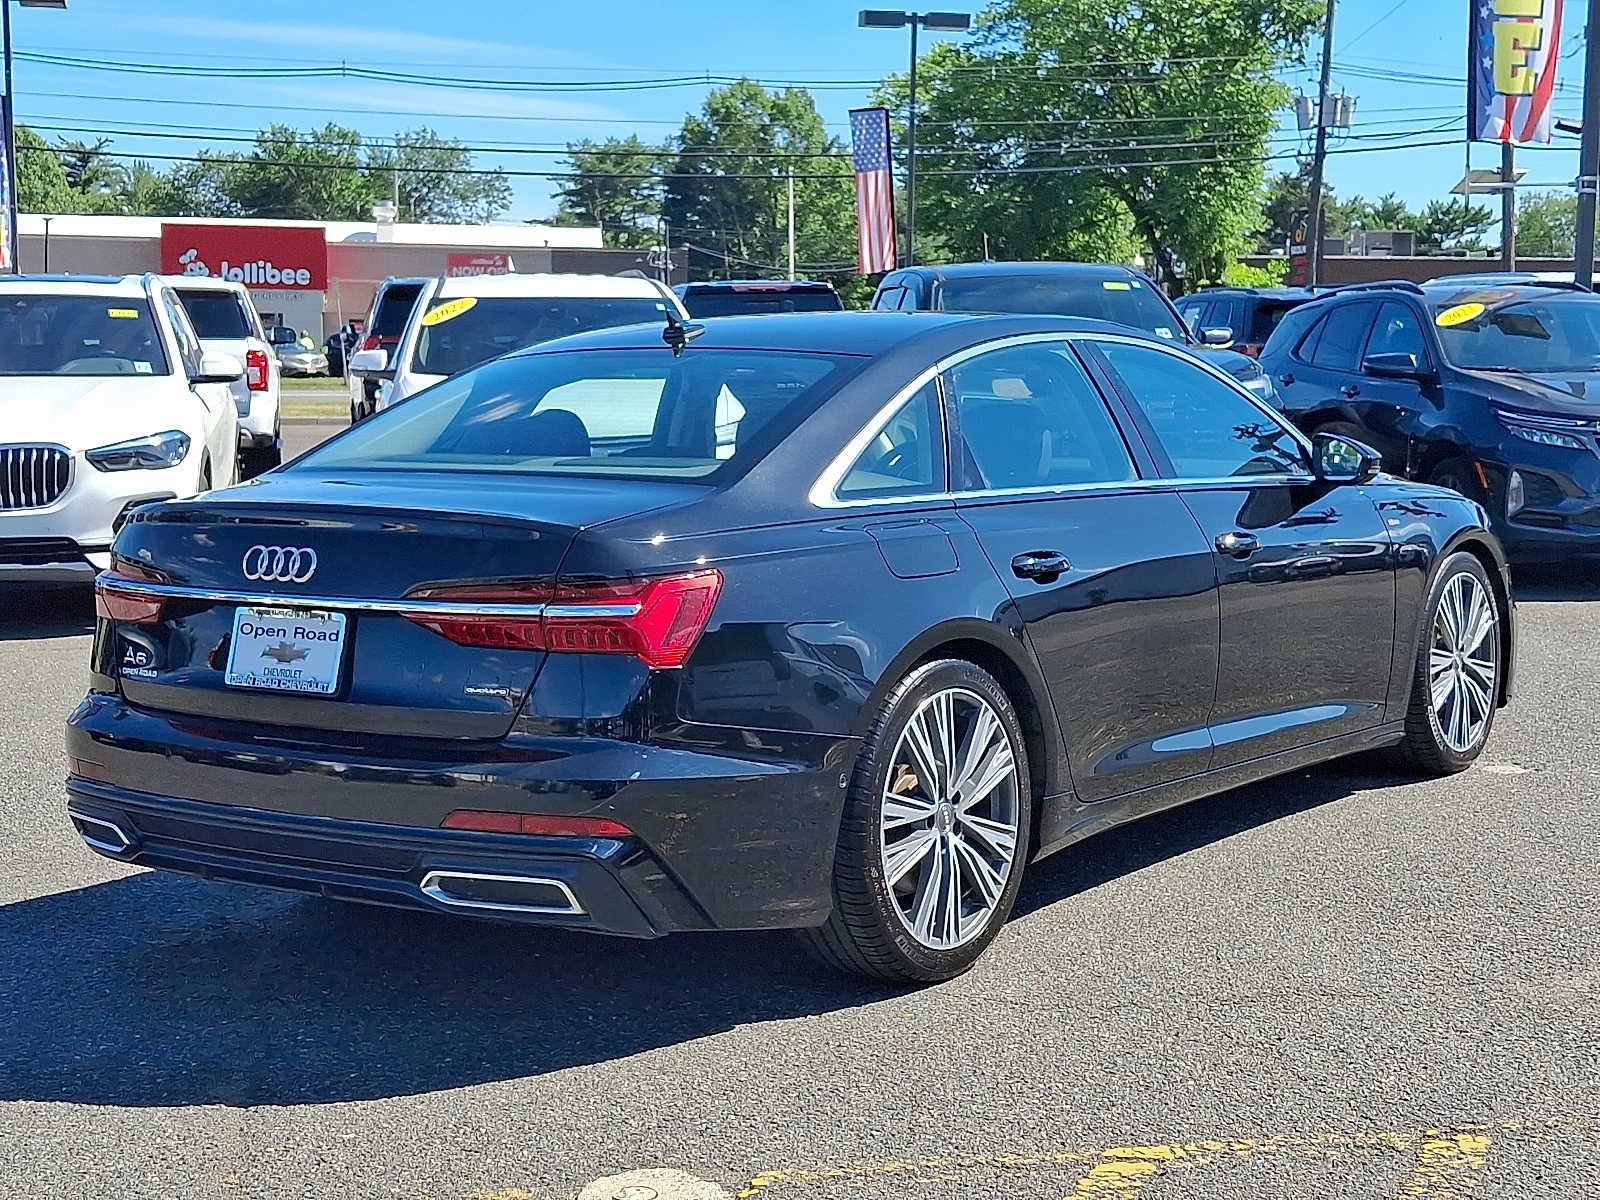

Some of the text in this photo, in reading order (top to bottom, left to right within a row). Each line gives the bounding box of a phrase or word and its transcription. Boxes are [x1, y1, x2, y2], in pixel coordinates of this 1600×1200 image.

[213, 260, 311, 286] Jollibee
[453, 266, 485, 277] NOW
[240, 622, 340, 642] Open Road
[123, 646, 147, 665] A6
[122, 667, 138, 675] OPEN
[263, 667, 303, 679] CHEVROLET
[230, 674, 329, 693] OPEN ROAD CHEVROLET
